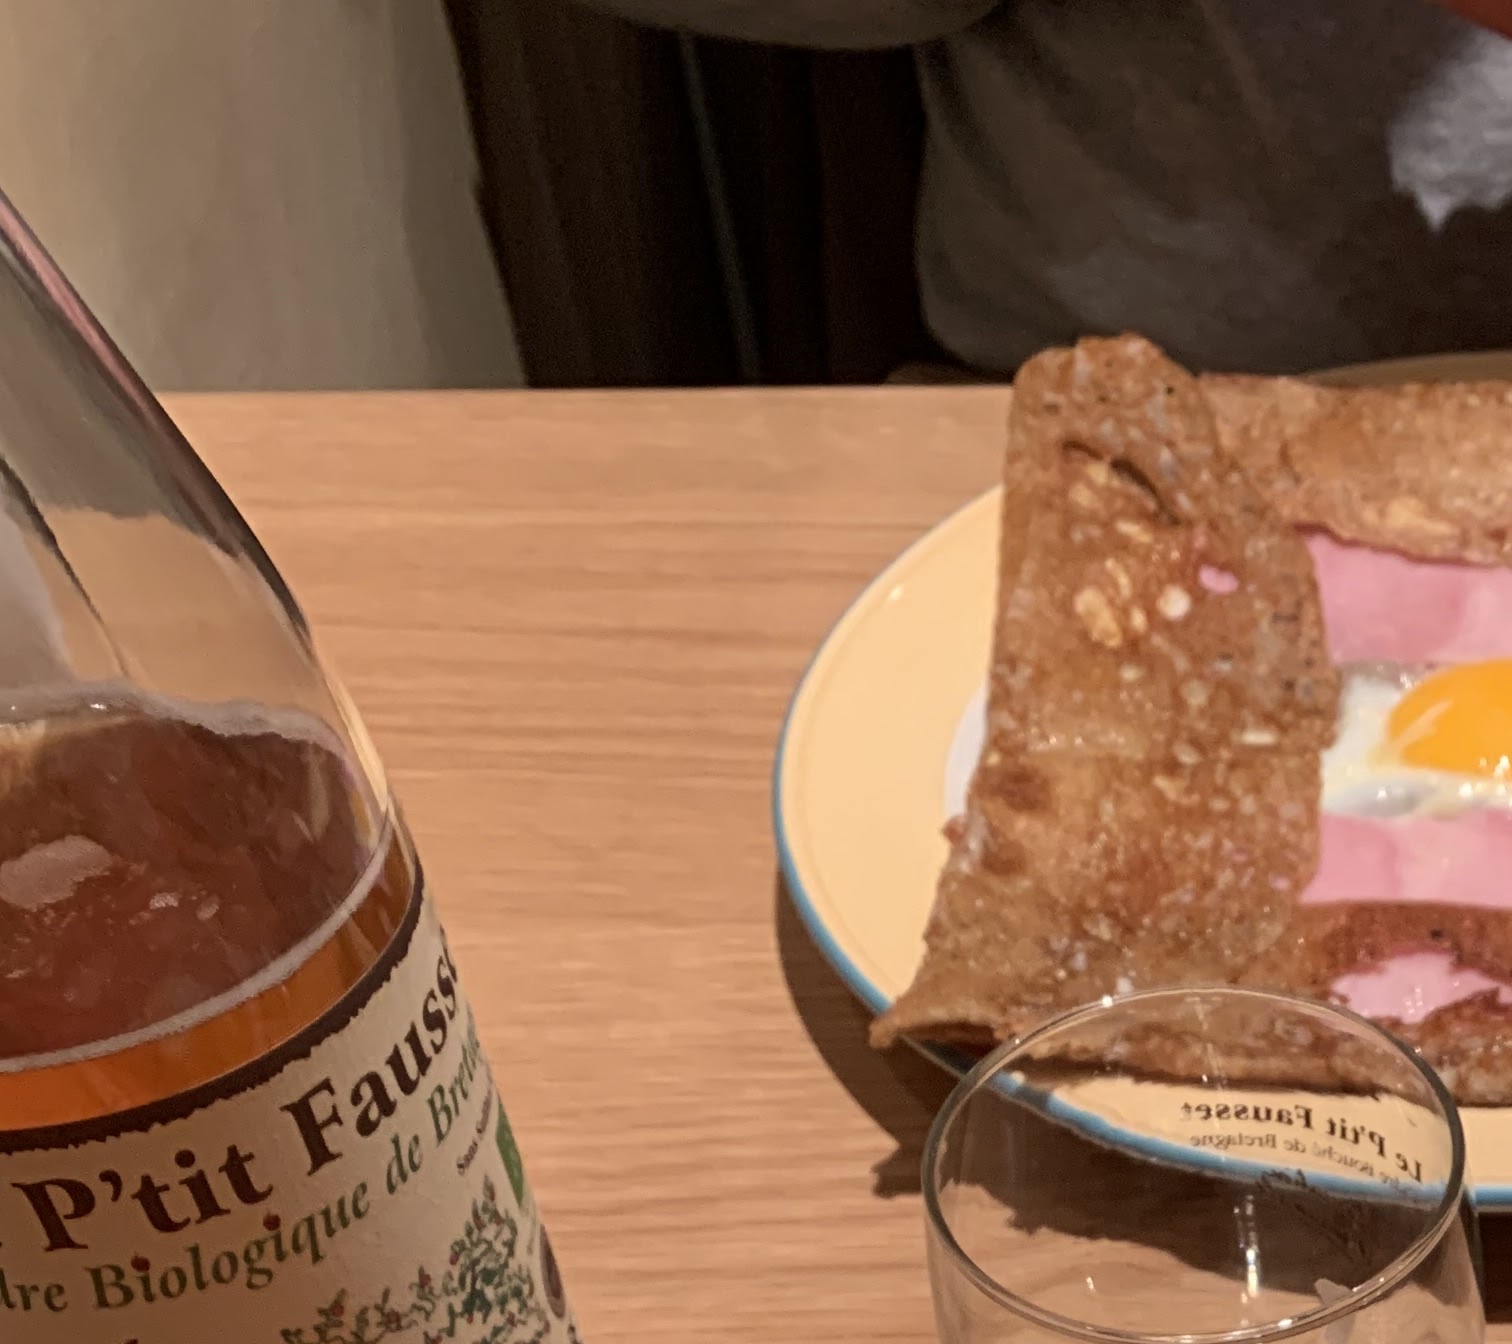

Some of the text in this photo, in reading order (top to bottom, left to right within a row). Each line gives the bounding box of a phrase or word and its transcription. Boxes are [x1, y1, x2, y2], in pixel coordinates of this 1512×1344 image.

[11, 1144, 273, 1252] P'tit
[85, 1181, 370, 1309] Biologique
[386, 1133, 423, 1195] de
